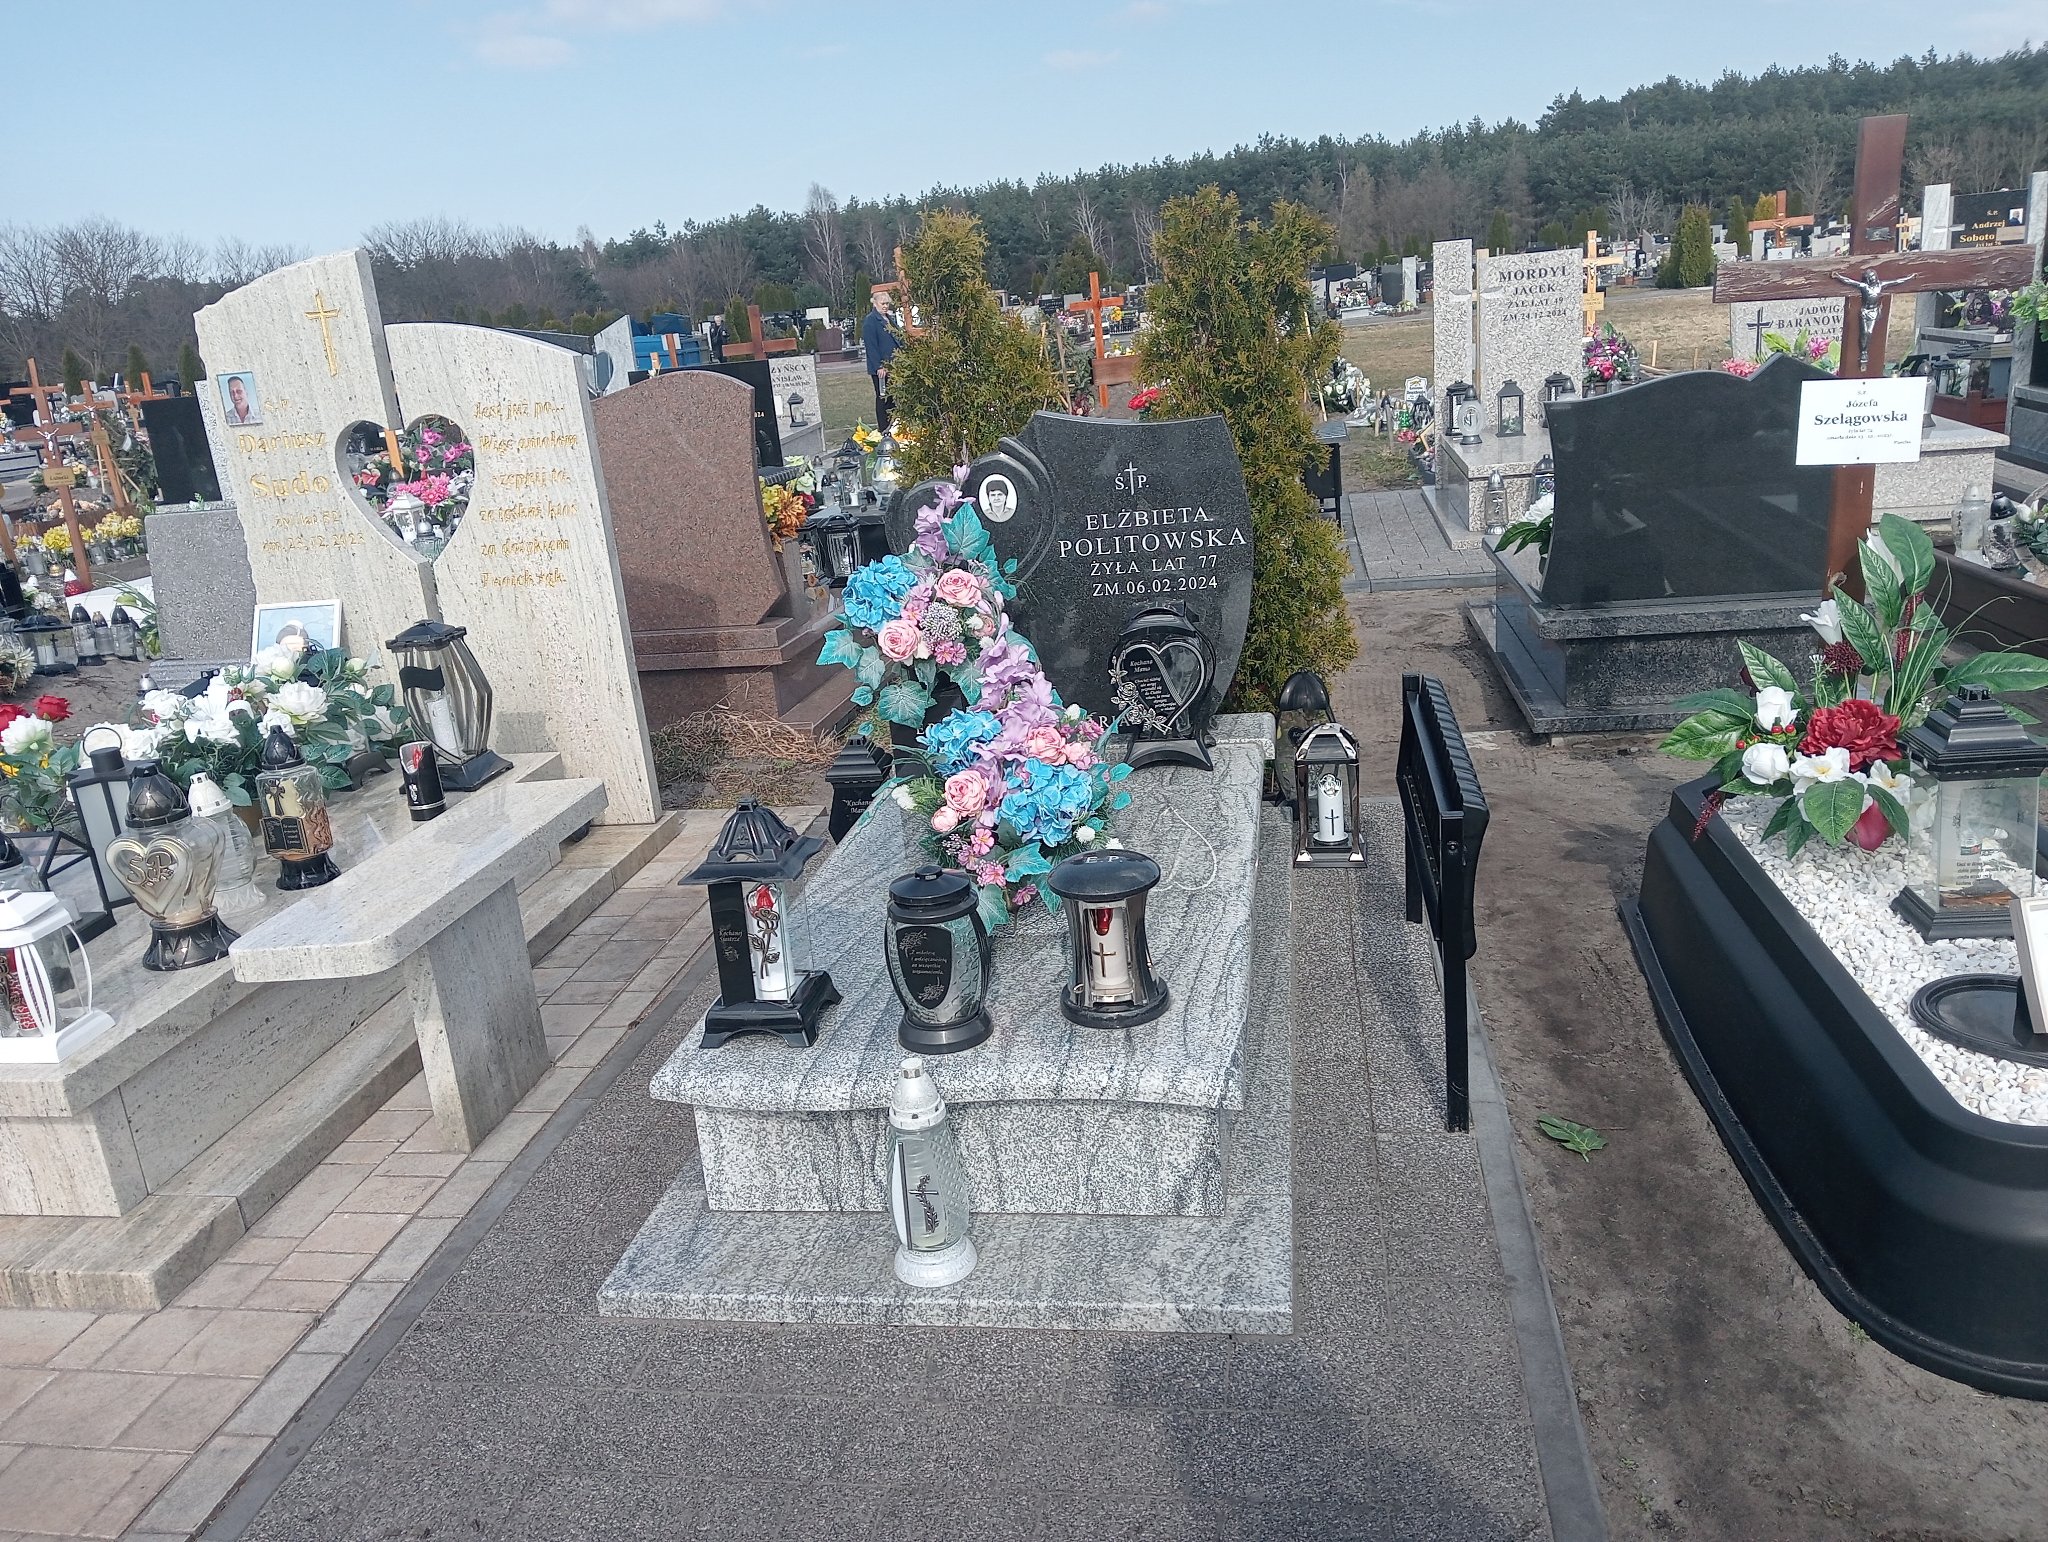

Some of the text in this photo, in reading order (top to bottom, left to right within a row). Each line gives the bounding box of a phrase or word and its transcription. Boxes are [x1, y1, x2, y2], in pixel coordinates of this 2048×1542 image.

[1971, 220, 2006, 230] Andrzej
[1512, 283, 1556, 296] JACEK
[1799, 304, 1844, 316] JADWIG
[1845, 398, 1879, 409] Józefa
[1814, 410, 1908, 427] Szelągowska
[238, 430, 327, 454] Dariusz
[250, 470, 331, 499] Sudo
[1085, 506, 1211, 531] ELŻBIETA
[1058, 526, 1248, 558] POLITOWSKA
[1090, 554, 1218, 577] ŻYŁA LAT 77
